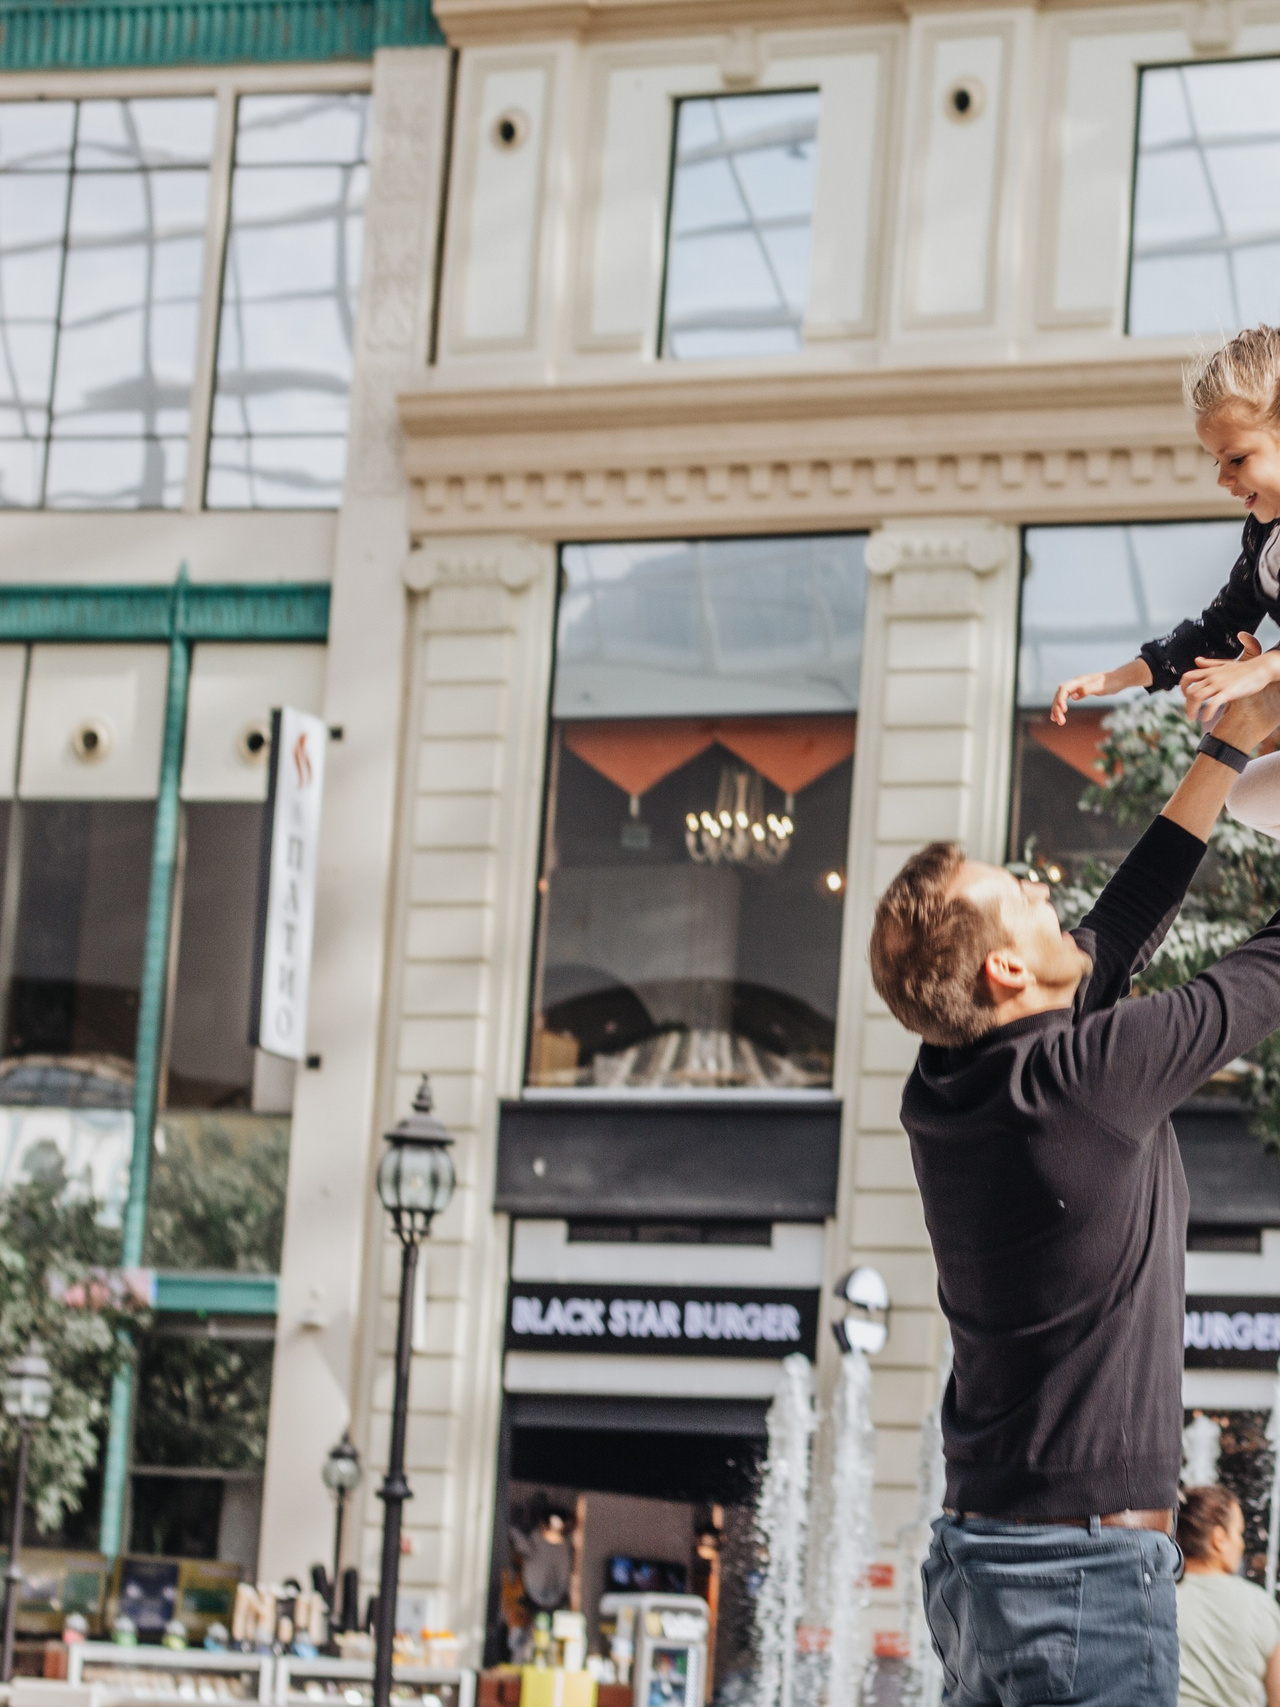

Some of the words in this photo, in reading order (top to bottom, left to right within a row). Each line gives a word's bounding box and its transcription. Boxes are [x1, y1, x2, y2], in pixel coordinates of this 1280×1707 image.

[511, 1295, 605, 1335] BLACK
[608, 1299, 682, 1338] STAR
[684, 1301, 801, 1341] BURGER
